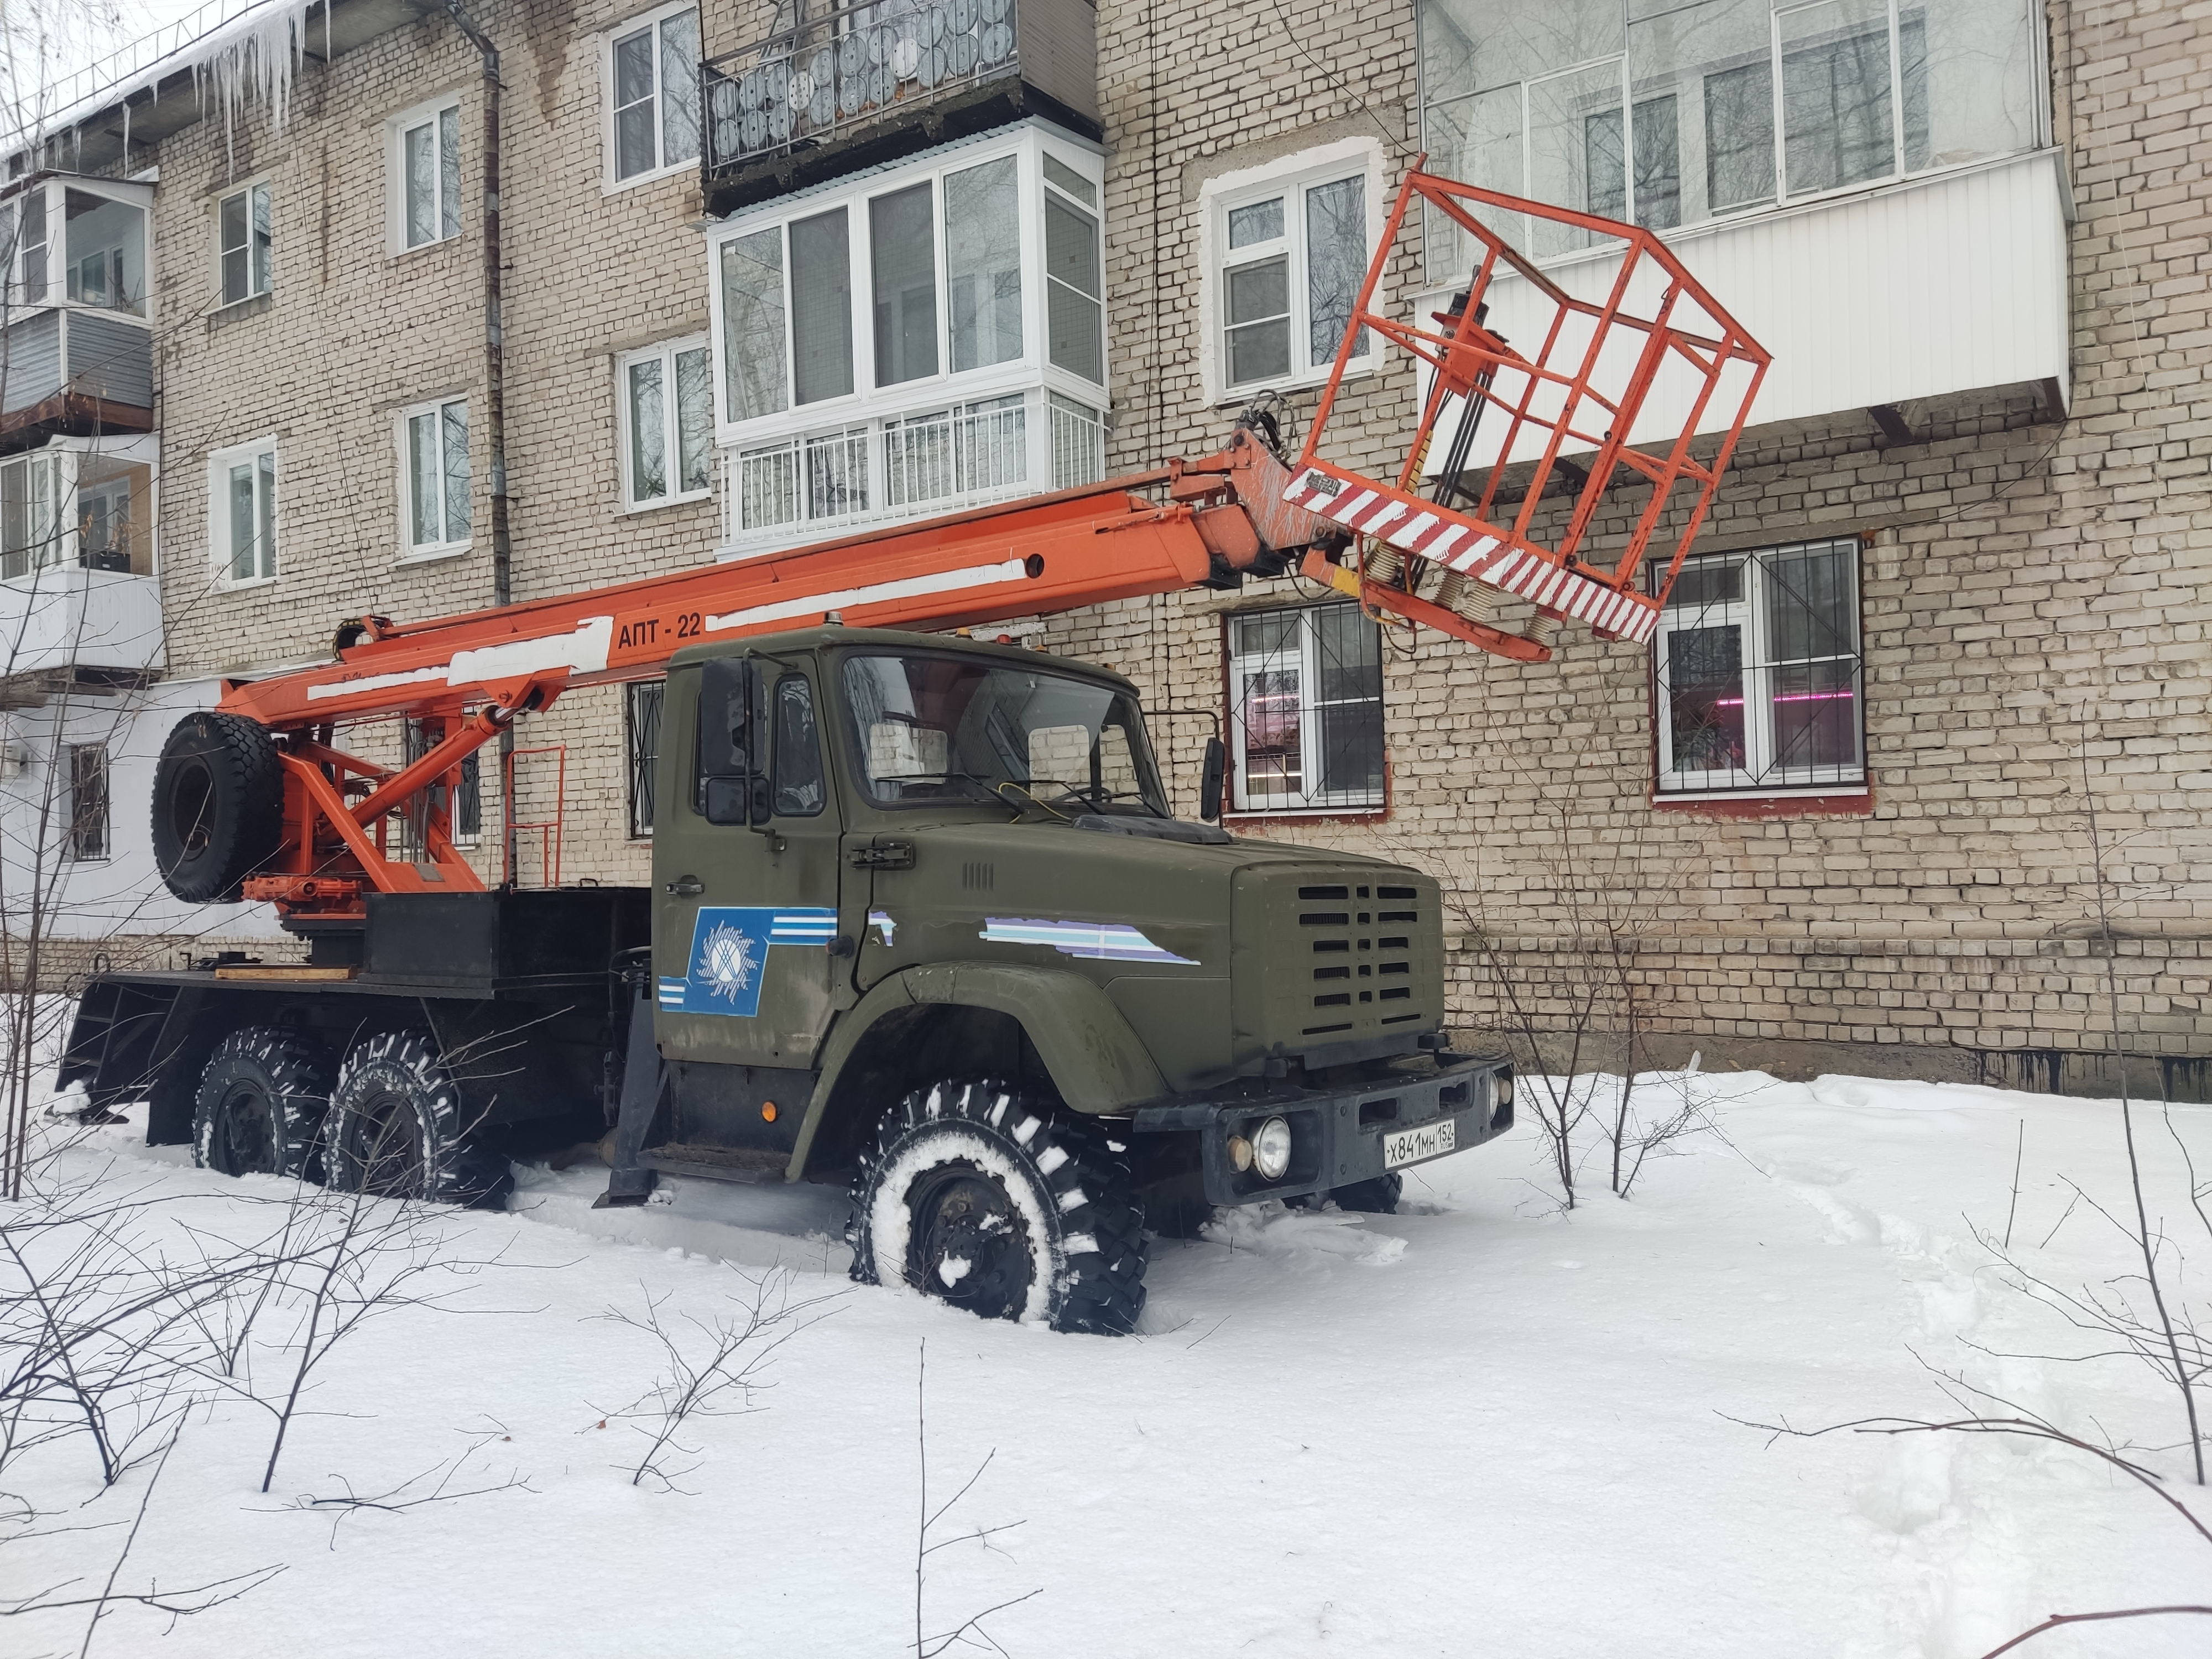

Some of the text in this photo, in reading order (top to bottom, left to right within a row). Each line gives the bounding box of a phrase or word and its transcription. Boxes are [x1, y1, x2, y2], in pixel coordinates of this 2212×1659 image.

[618, 619, 659, 649] АПТ
[677, 612, 700, 638] 22
[1390, 1123, 1452, 1163] Х841МН 152
